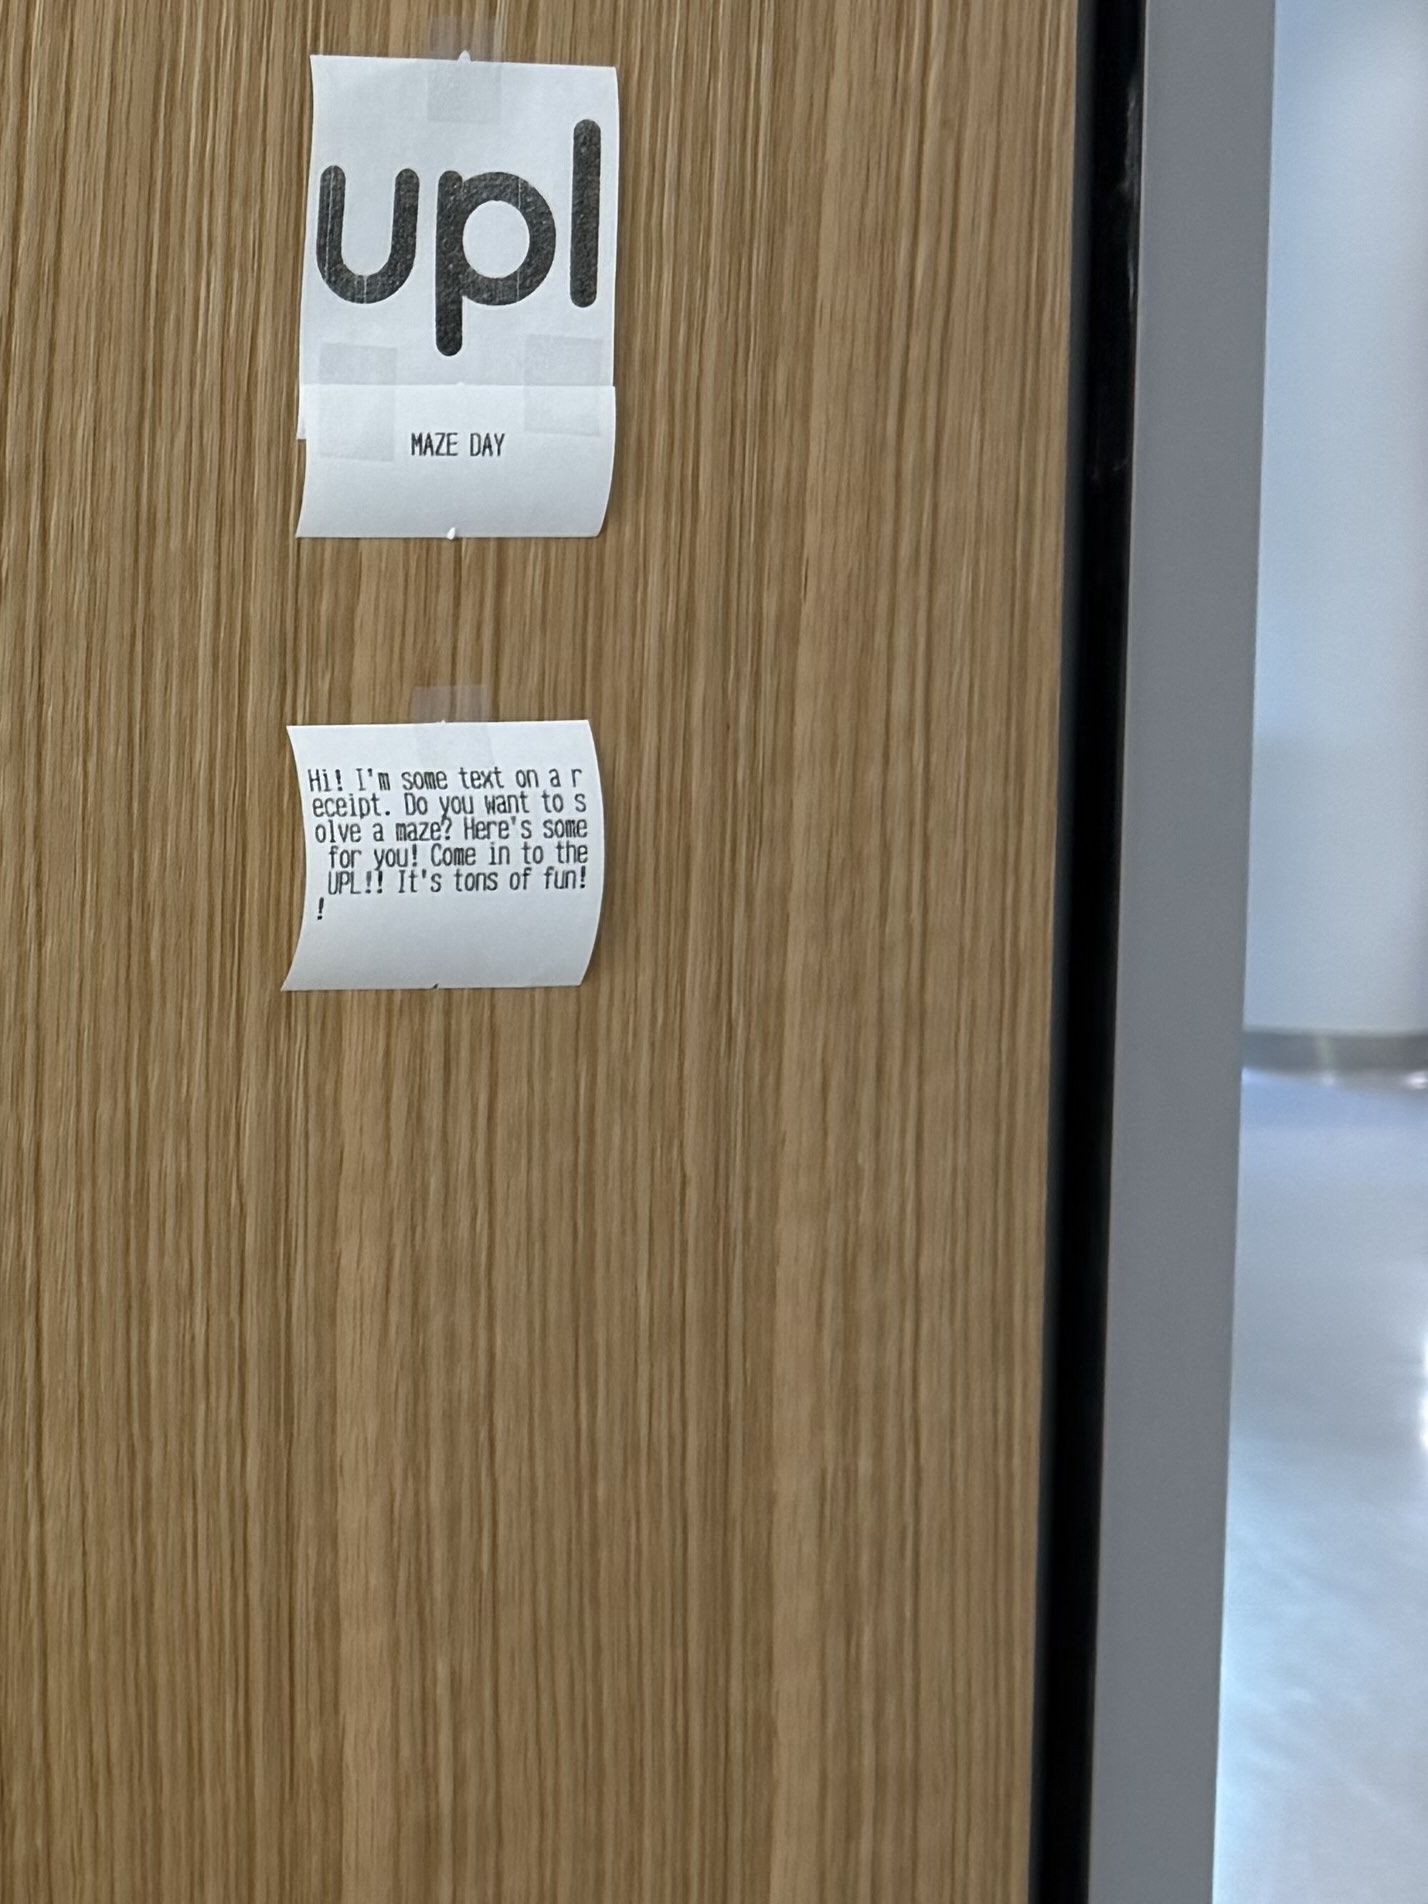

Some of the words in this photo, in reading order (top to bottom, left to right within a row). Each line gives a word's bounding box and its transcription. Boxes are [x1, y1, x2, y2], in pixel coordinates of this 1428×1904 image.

[316, 119, 602, 357] upl
[411, 432, 459, 457] MAZE
[469, 432, 506, 457] DAY
[308, 768, 344, 792] Hi!
[356, 768, 390, 791] I'm
[401, 769, 448, 790] some
[458, 766, 504, 789] text
[516, 769, 539, 788] on
[549, 770, 561, 788] a
[571, 769, 582, 787] r
[312, 794, 392, 820] eceipt.
[404, 793, 428, 815] Do
[439, 794, 474, 818] you
[484, 792, 530, 814] want
[542, 790, 564, 813] to
[575, 793, 586, 812] s
[315, 821, 362, 843] olve
[372, 822, 384, 841] a
[396, 818, 452, 841] maze?
[464, 816, 532, 840] Here's
[543, 819, 588, 838] some
[328, 846, 362, 868] for
[374, 844, 418, 870] you!
[430, 844, 476, 866] Come
[488, 844, 510, 865] in
[522, 843, 544, 864] to
[556, 841, 588, 863] the
[328, 870, 384, 894] UPL!!
[398, 870, 442, 894] It's
[454, 869, 498, 892] tons
[510, 868, 532, 890] of
[543, 866, 586, 890] fun!
[317, 897, 324, 920] !
